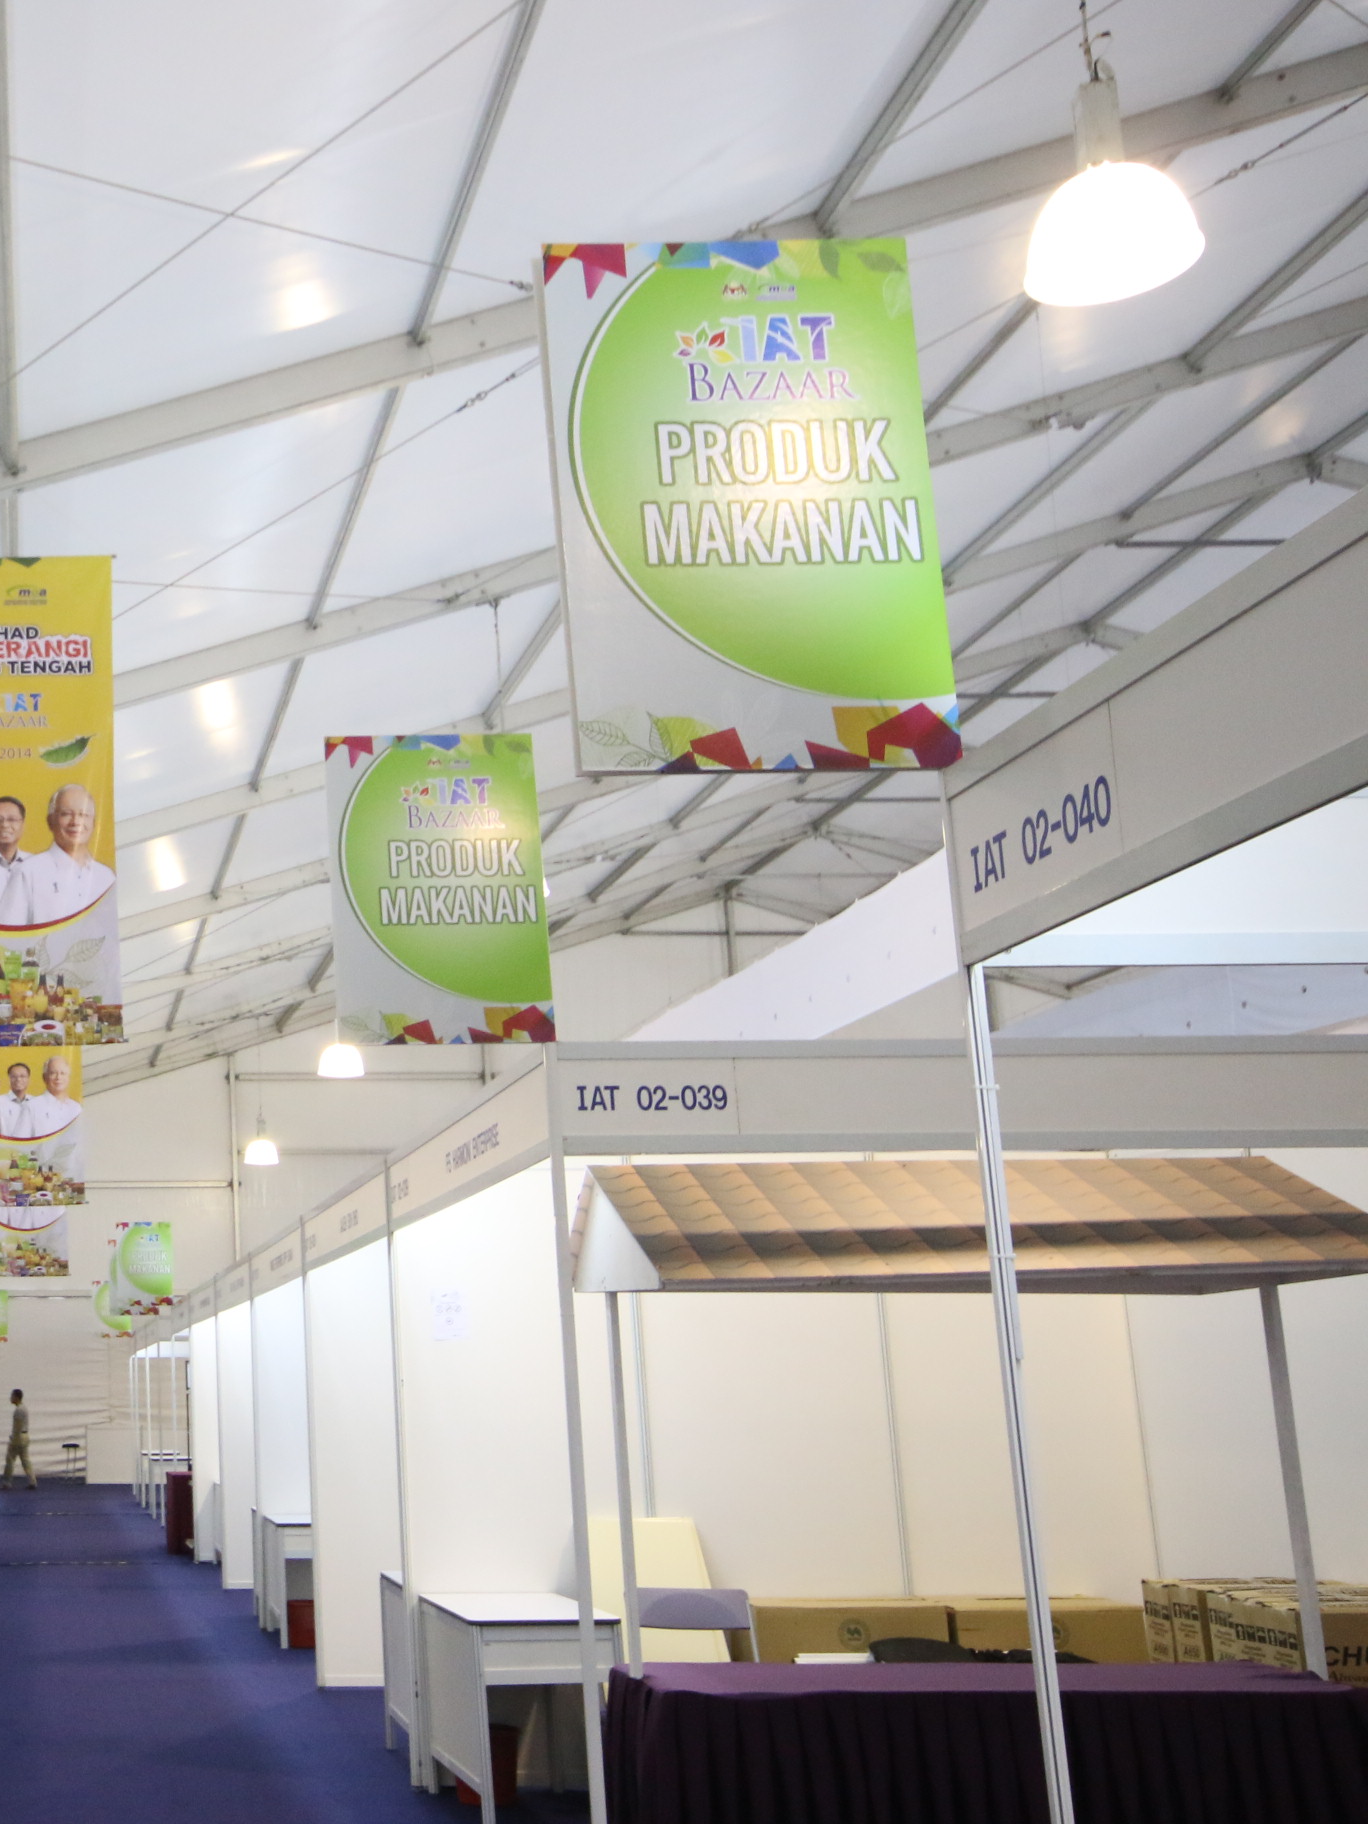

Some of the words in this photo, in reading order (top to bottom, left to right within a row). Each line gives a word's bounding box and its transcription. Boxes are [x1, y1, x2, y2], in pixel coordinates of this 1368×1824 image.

[735, 314, 833, 361] IAT
[688, 363, 854, 401] BAZAAR
[655, 418, 898, 486] PRODUK
[641, 497, 923, 567] MAKANAN
[8, 661, 91, 674] TENGAH
[3, 693, 42, 712] IAT
[0, 748, 32, 760] 2014
[438, 777, 490, 805] IAT
[408, 805, 505, 829] BAZAAR
[971, 830, 1007, 893] IAT
[1021, 775, 1111, 865] 02-040
[388, 838, 524, 878] PRODUK
[379, 885, 538, 925] MAKANAN
[577, 1085, 620, 1111] IAT
[637, 1085, 728, 1111] 02-039
